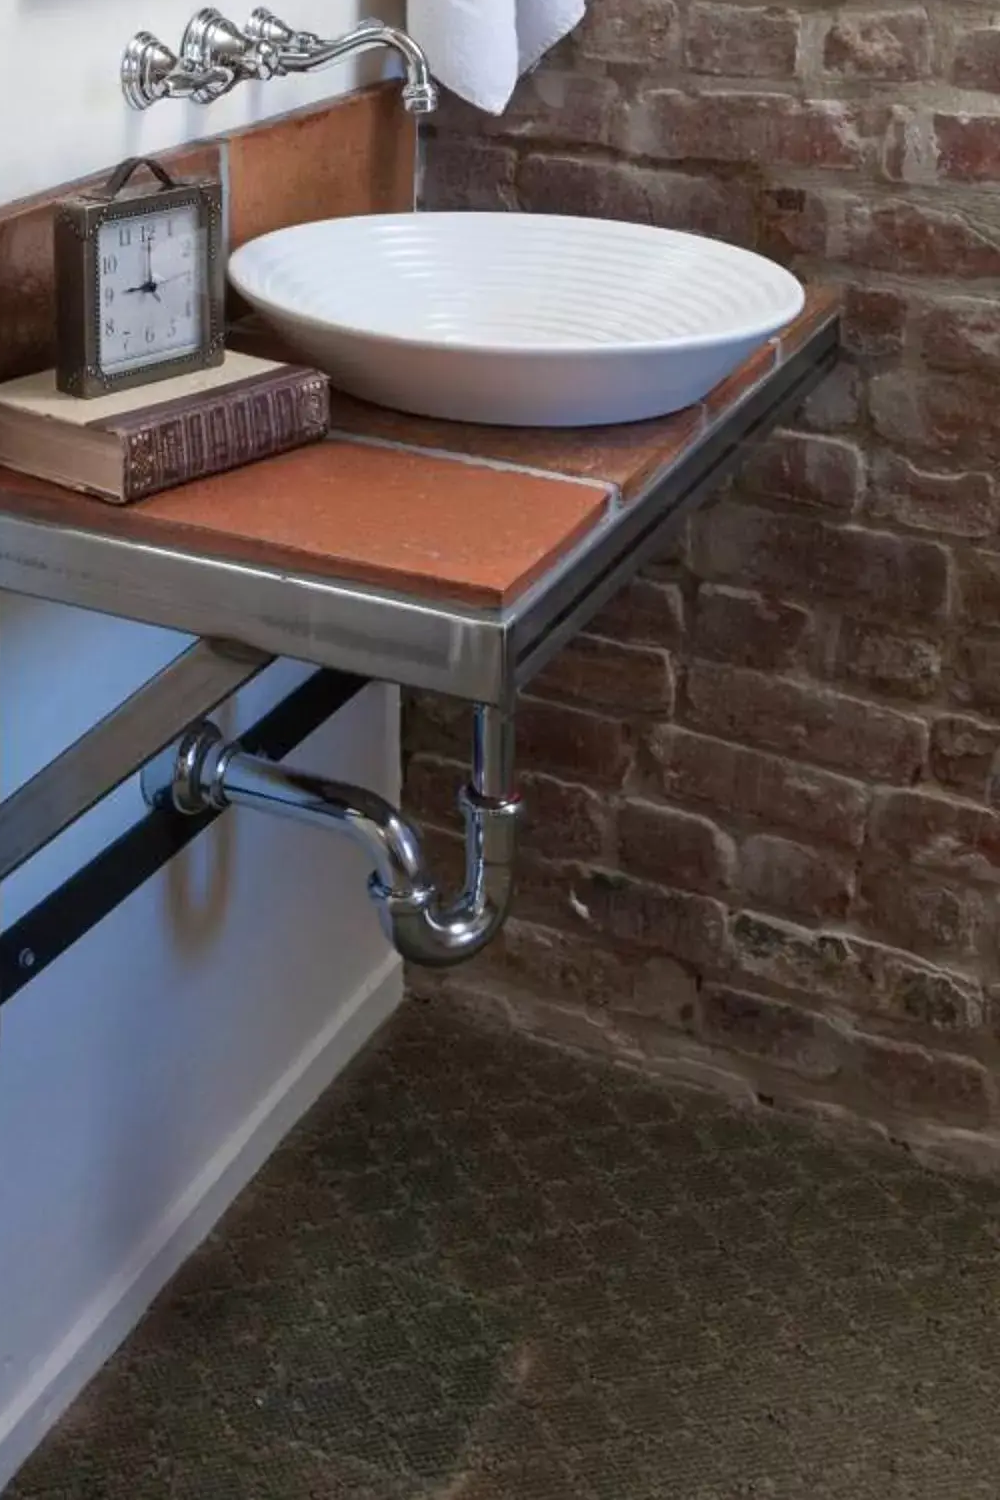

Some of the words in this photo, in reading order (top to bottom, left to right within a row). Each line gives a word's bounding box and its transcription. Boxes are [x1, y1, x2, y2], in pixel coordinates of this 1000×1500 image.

[140, 223, 155, 243] 12
[103, 255, 118, 275] 10
[104, 286, 114, 308] 9
[105, 318, 115, 338] 8
[144, 325, 155, 344] 6
[123, 330, 132, 351] 7
